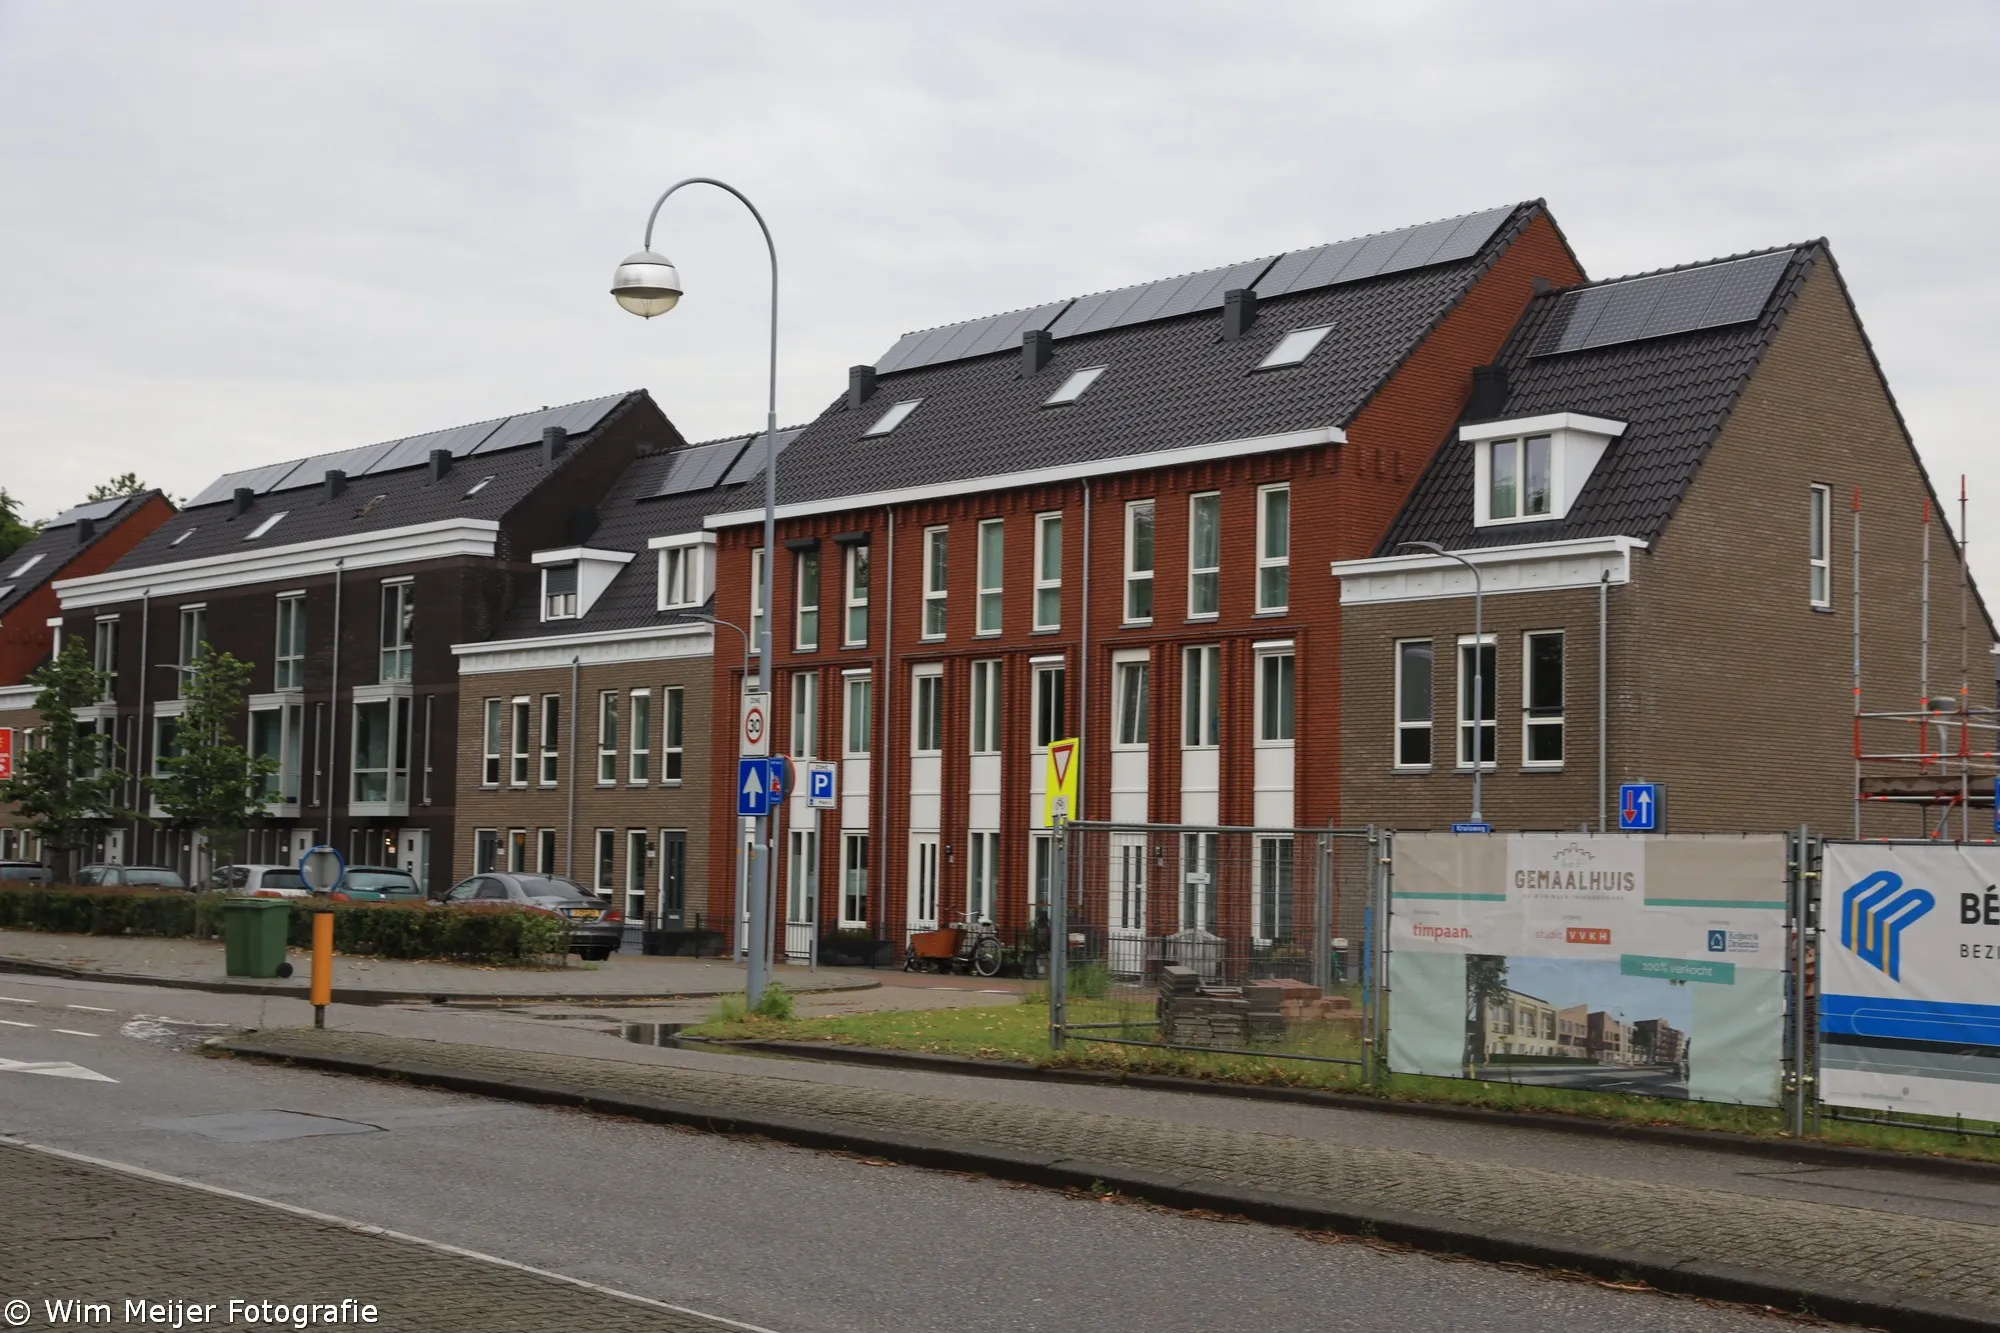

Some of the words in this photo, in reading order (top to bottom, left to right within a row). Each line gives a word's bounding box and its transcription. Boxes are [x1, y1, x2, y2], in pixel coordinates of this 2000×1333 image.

[749, 718, 761, 733] 30
[814, 773, 829, 795] P
[1514, 869, 1635, 892] GEMAALHUIS
[1412, 921, 1473, 941] timpaan.
